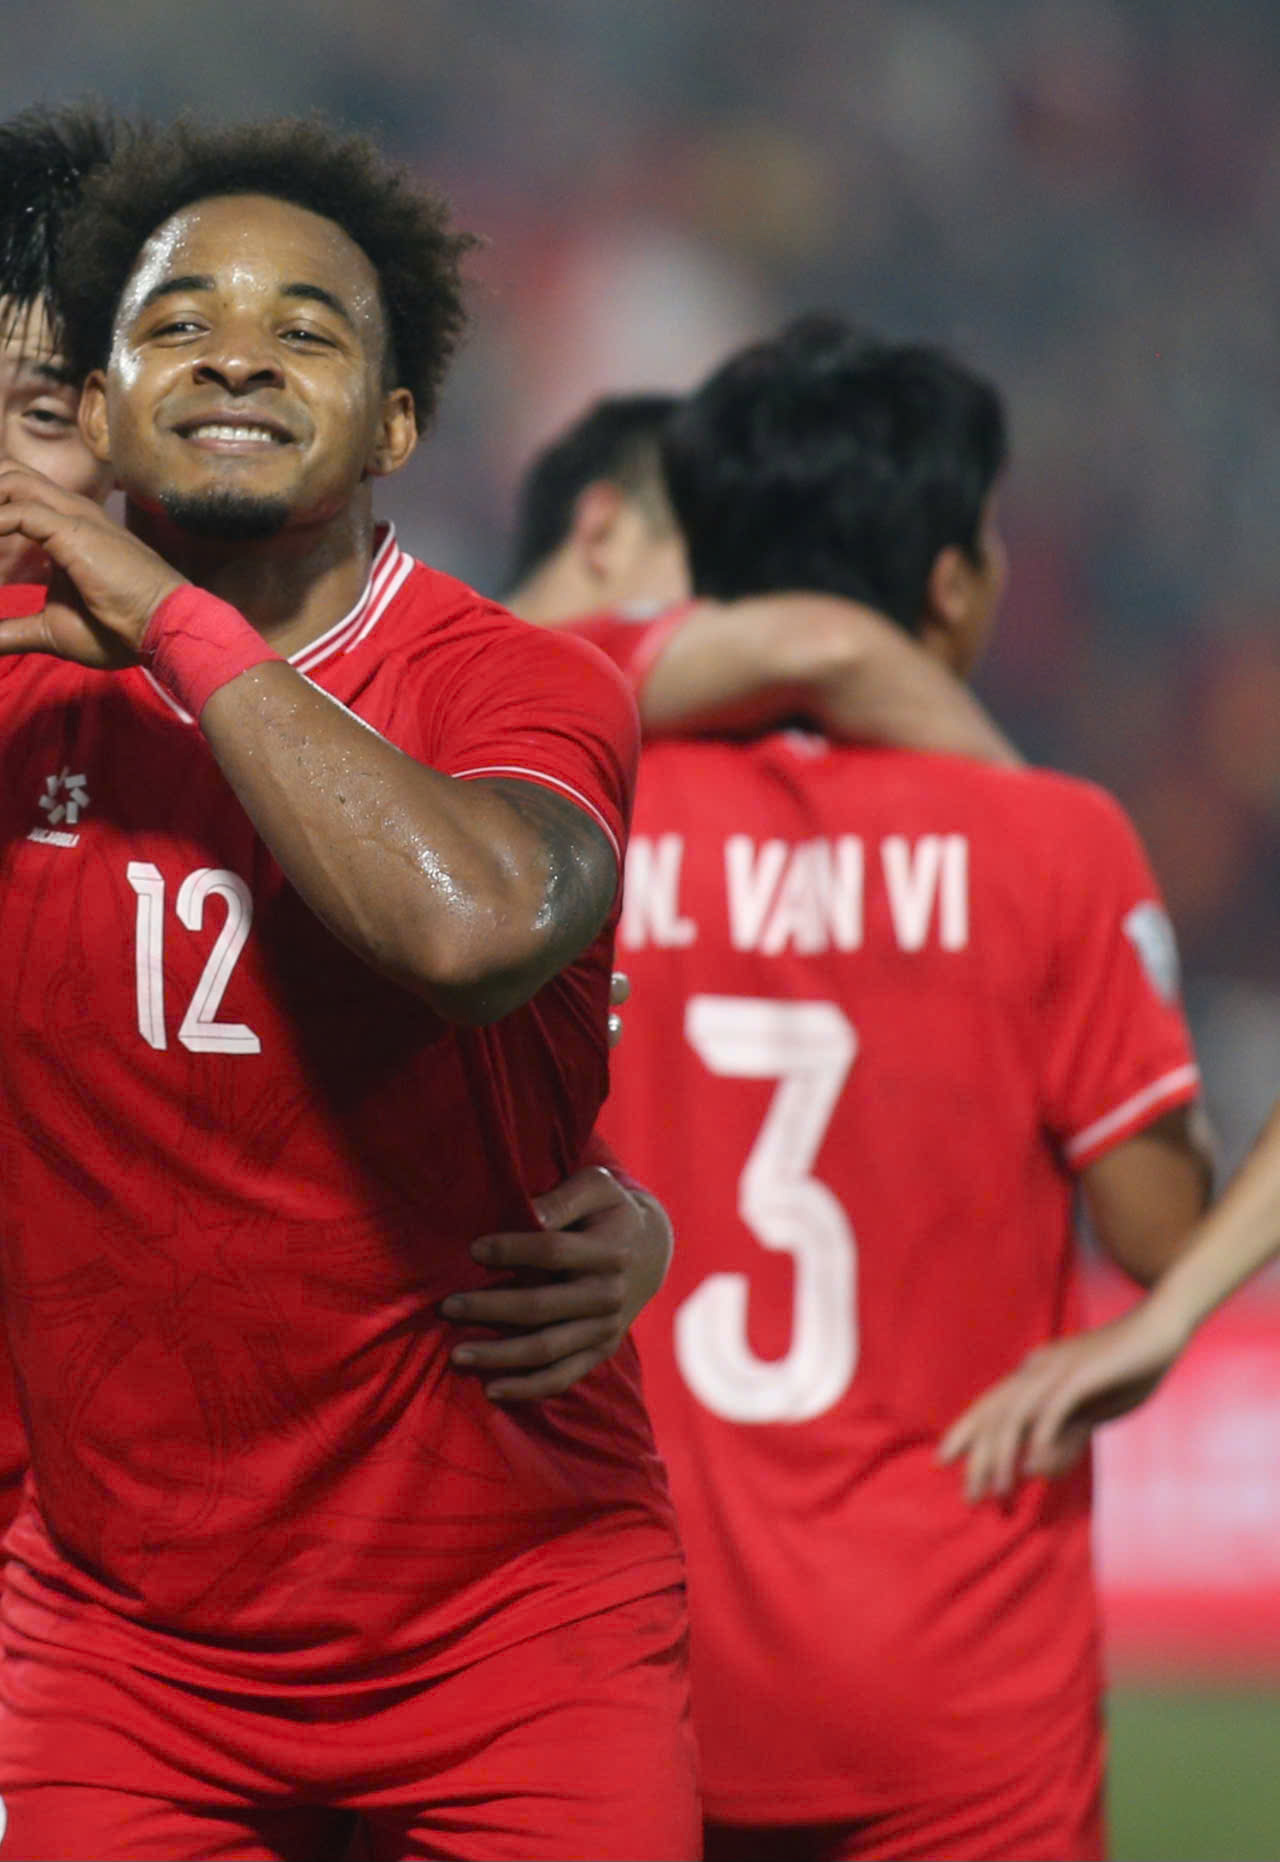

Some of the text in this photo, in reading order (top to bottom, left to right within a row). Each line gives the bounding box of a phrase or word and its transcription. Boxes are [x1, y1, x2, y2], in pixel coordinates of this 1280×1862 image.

[126, 861, 262, 1054] 12
[622, 833, 968, 956] N. VAN VI
[676, 994, 859, 1424] 3
